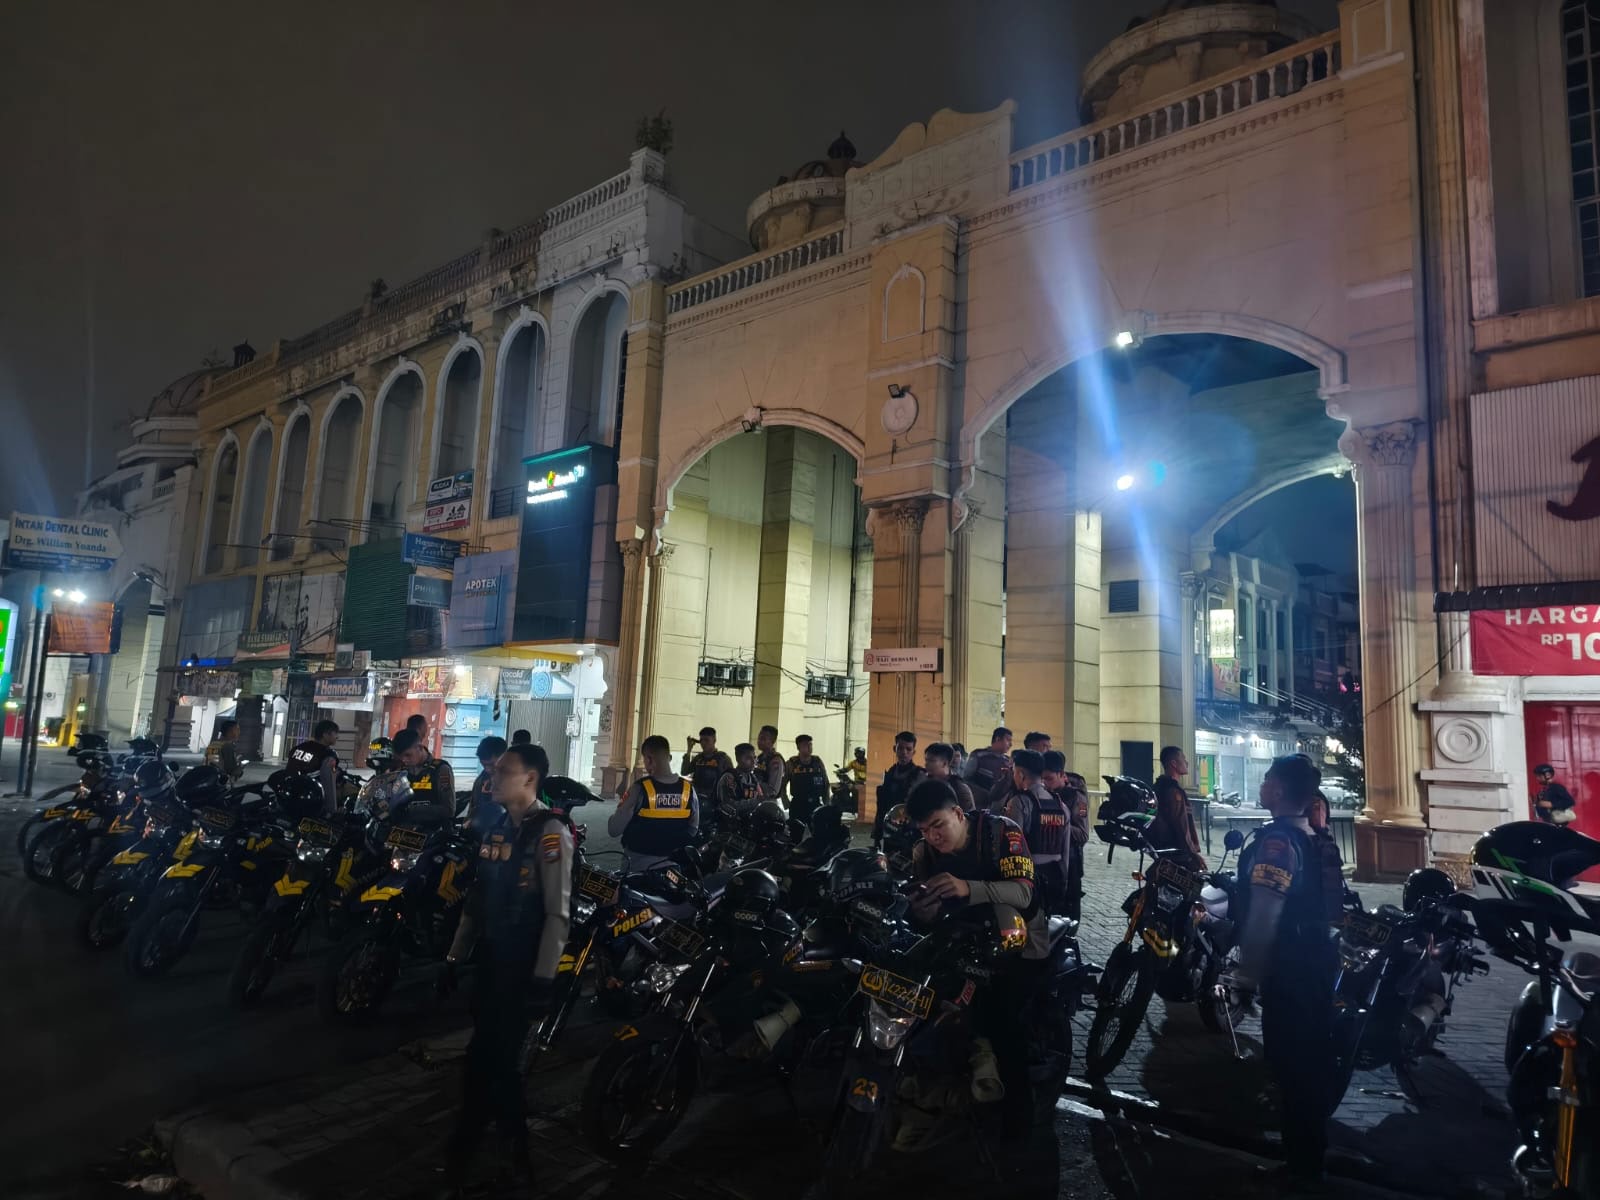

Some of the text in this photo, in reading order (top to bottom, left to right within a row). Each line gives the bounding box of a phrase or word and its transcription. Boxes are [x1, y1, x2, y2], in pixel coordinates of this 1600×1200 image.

[15, 517, 108, 538] INTAN DENTAL CLINIC
[36, 536, 73, 548] William
[465, 577, 497, 590] APOTEK
[320, 679, 362, 695] Hannochs
[658, 797, 680, 806] POLISI
[1040, 813, 1065, 826] POLISI
[613, 907, 653, 938] POLISI
